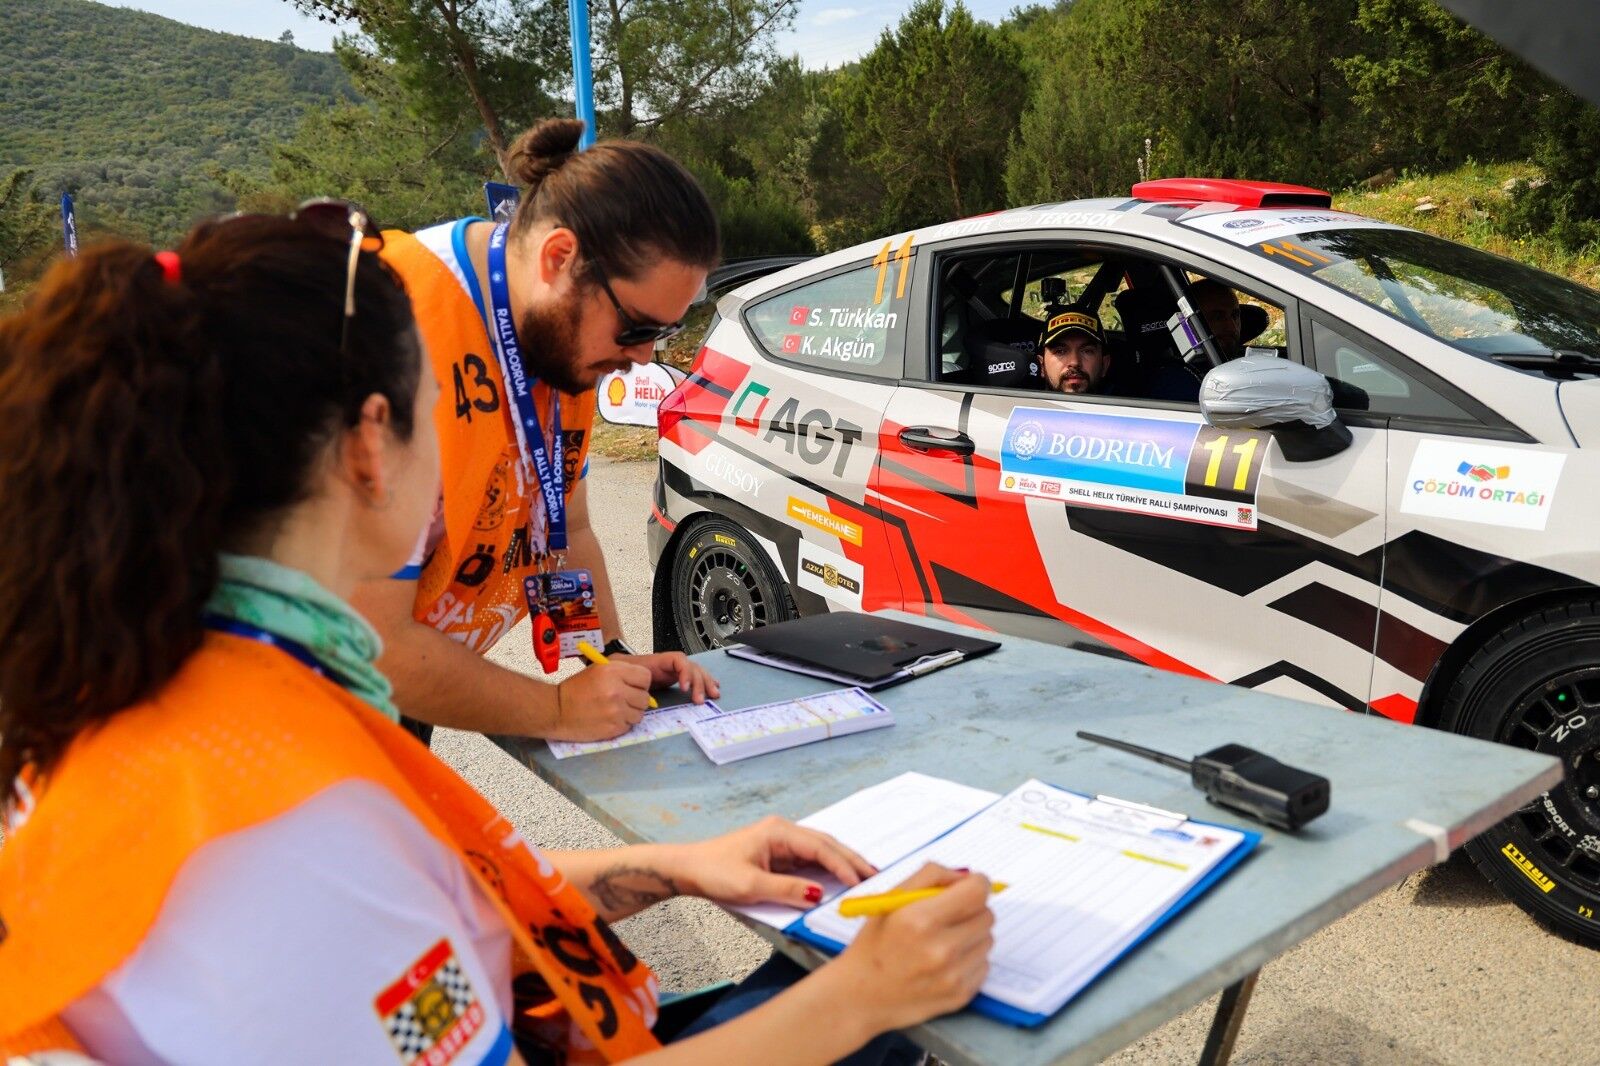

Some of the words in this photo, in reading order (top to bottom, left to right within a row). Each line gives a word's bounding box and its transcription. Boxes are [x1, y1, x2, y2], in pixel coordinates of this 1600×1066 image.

[1034, 211, 1122, 229] TEROSON
[872, 234, 916, 305] 11
[1260, 239, 1333, 267] 11
[497, 308, 516, 345] RALLY
[808, 308, 824, 327] S.
[829, 307, 898, 329] Türkkan
[801, 335, 817, 355] K.
[819, 336, 875, 361] Akgün
[505, 346, 528, 397] BODRUM
[635, 375, 650, 386] Shell
[987, 360, 1016, 375] sparco
[452, 352, 500, 424] 43
[634, 386, 667, 401] HELIX
[762, 397, 863, 478] AGT
[1046, 431, 1176, 470] BODRUM
[704, 451, 764, 499] GÜRSOY
[1203, 434, 1258, 491] 11
[533, 446, 551, 481] RALLY
[542, 480, 561, 523] BODRUM
[1413, 478, 1475, 498] ÇÖZÜM
[1479, 487, 1546, 506] ORTAĞI
[1068, 487, 1091, 497] SHELL
[1092, 490, 1115, 501] HELIX
[1116, 493, 1148, 506] TÜRKİYE
[1149, 498, 1172, 510] RALLİ
[1172, 502, 1228, 518] ŞAMPİYONASI
[795, 506, 858, 539] YEMEKHANE
[804, 562, 824, 577] AZKA
[1501, 842, 1556, 894] PIRELLI
